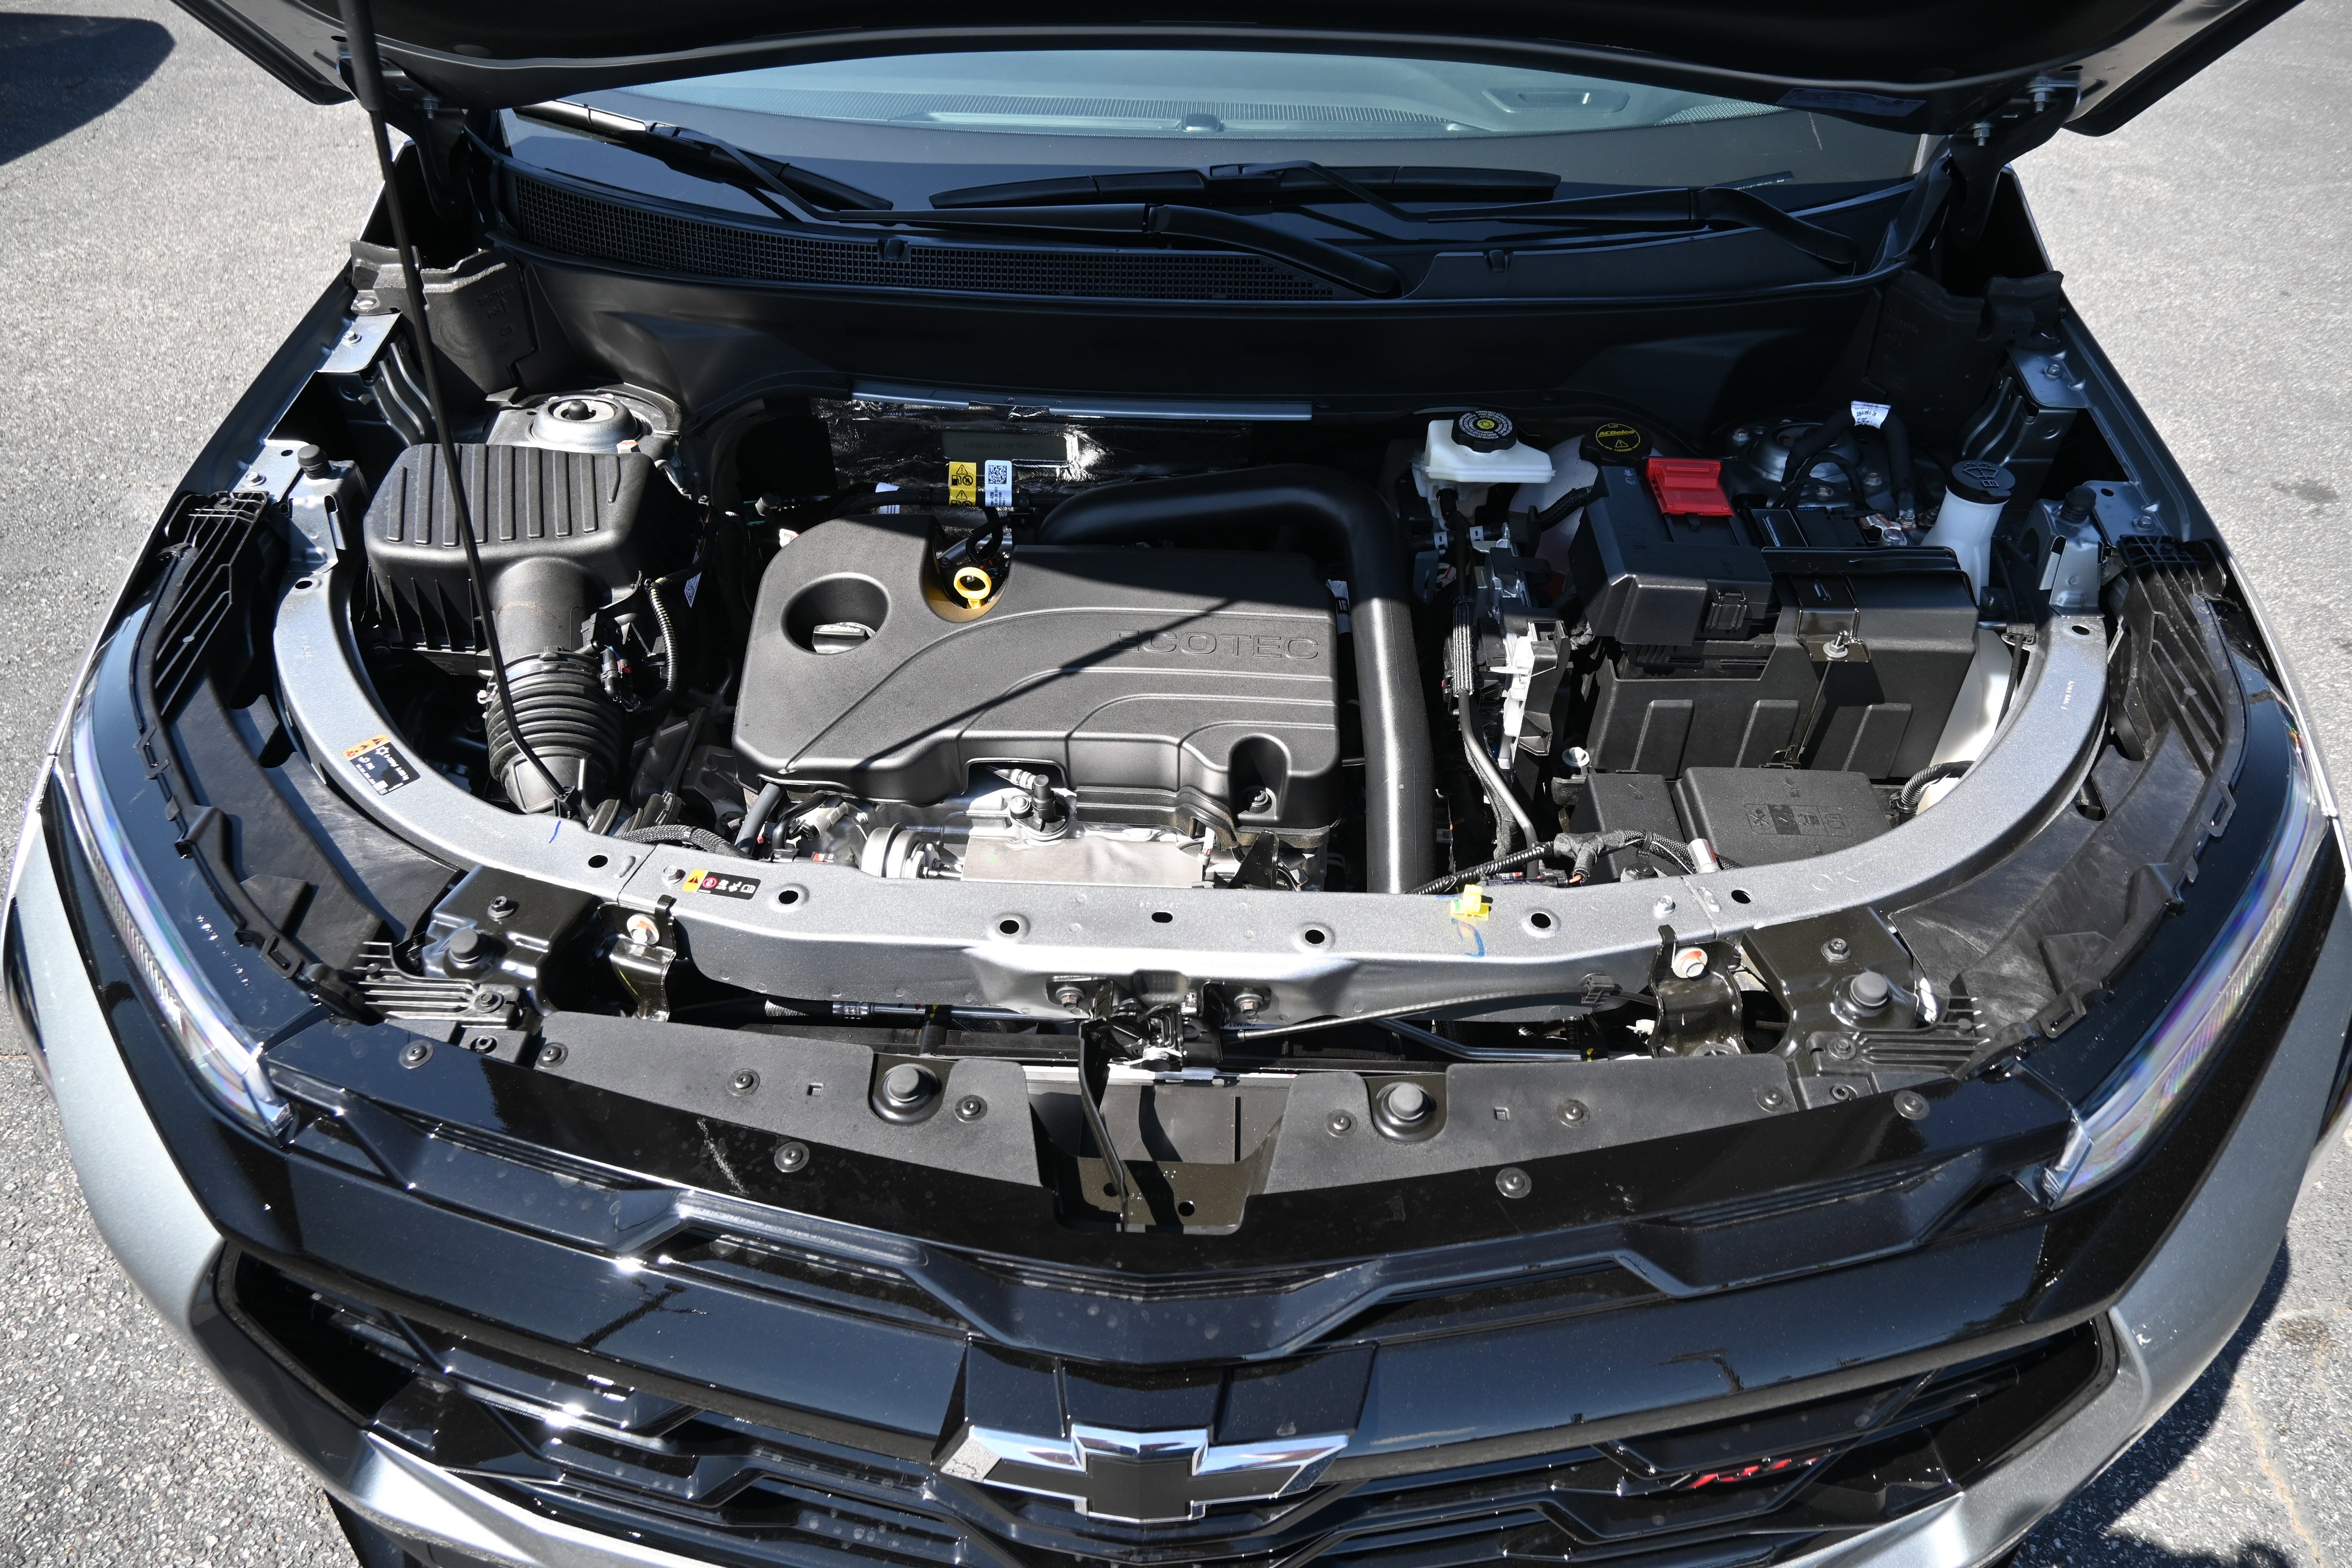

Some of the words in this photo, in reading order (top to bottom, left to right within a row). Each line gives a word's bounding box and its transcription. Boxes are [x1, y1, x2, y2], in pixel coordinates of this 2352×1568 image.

[1341, 600, 1348, 611] GM
[818, 625, 861, 633] ACDelco
[1109, 629, 1319, 660] ECOTEC
